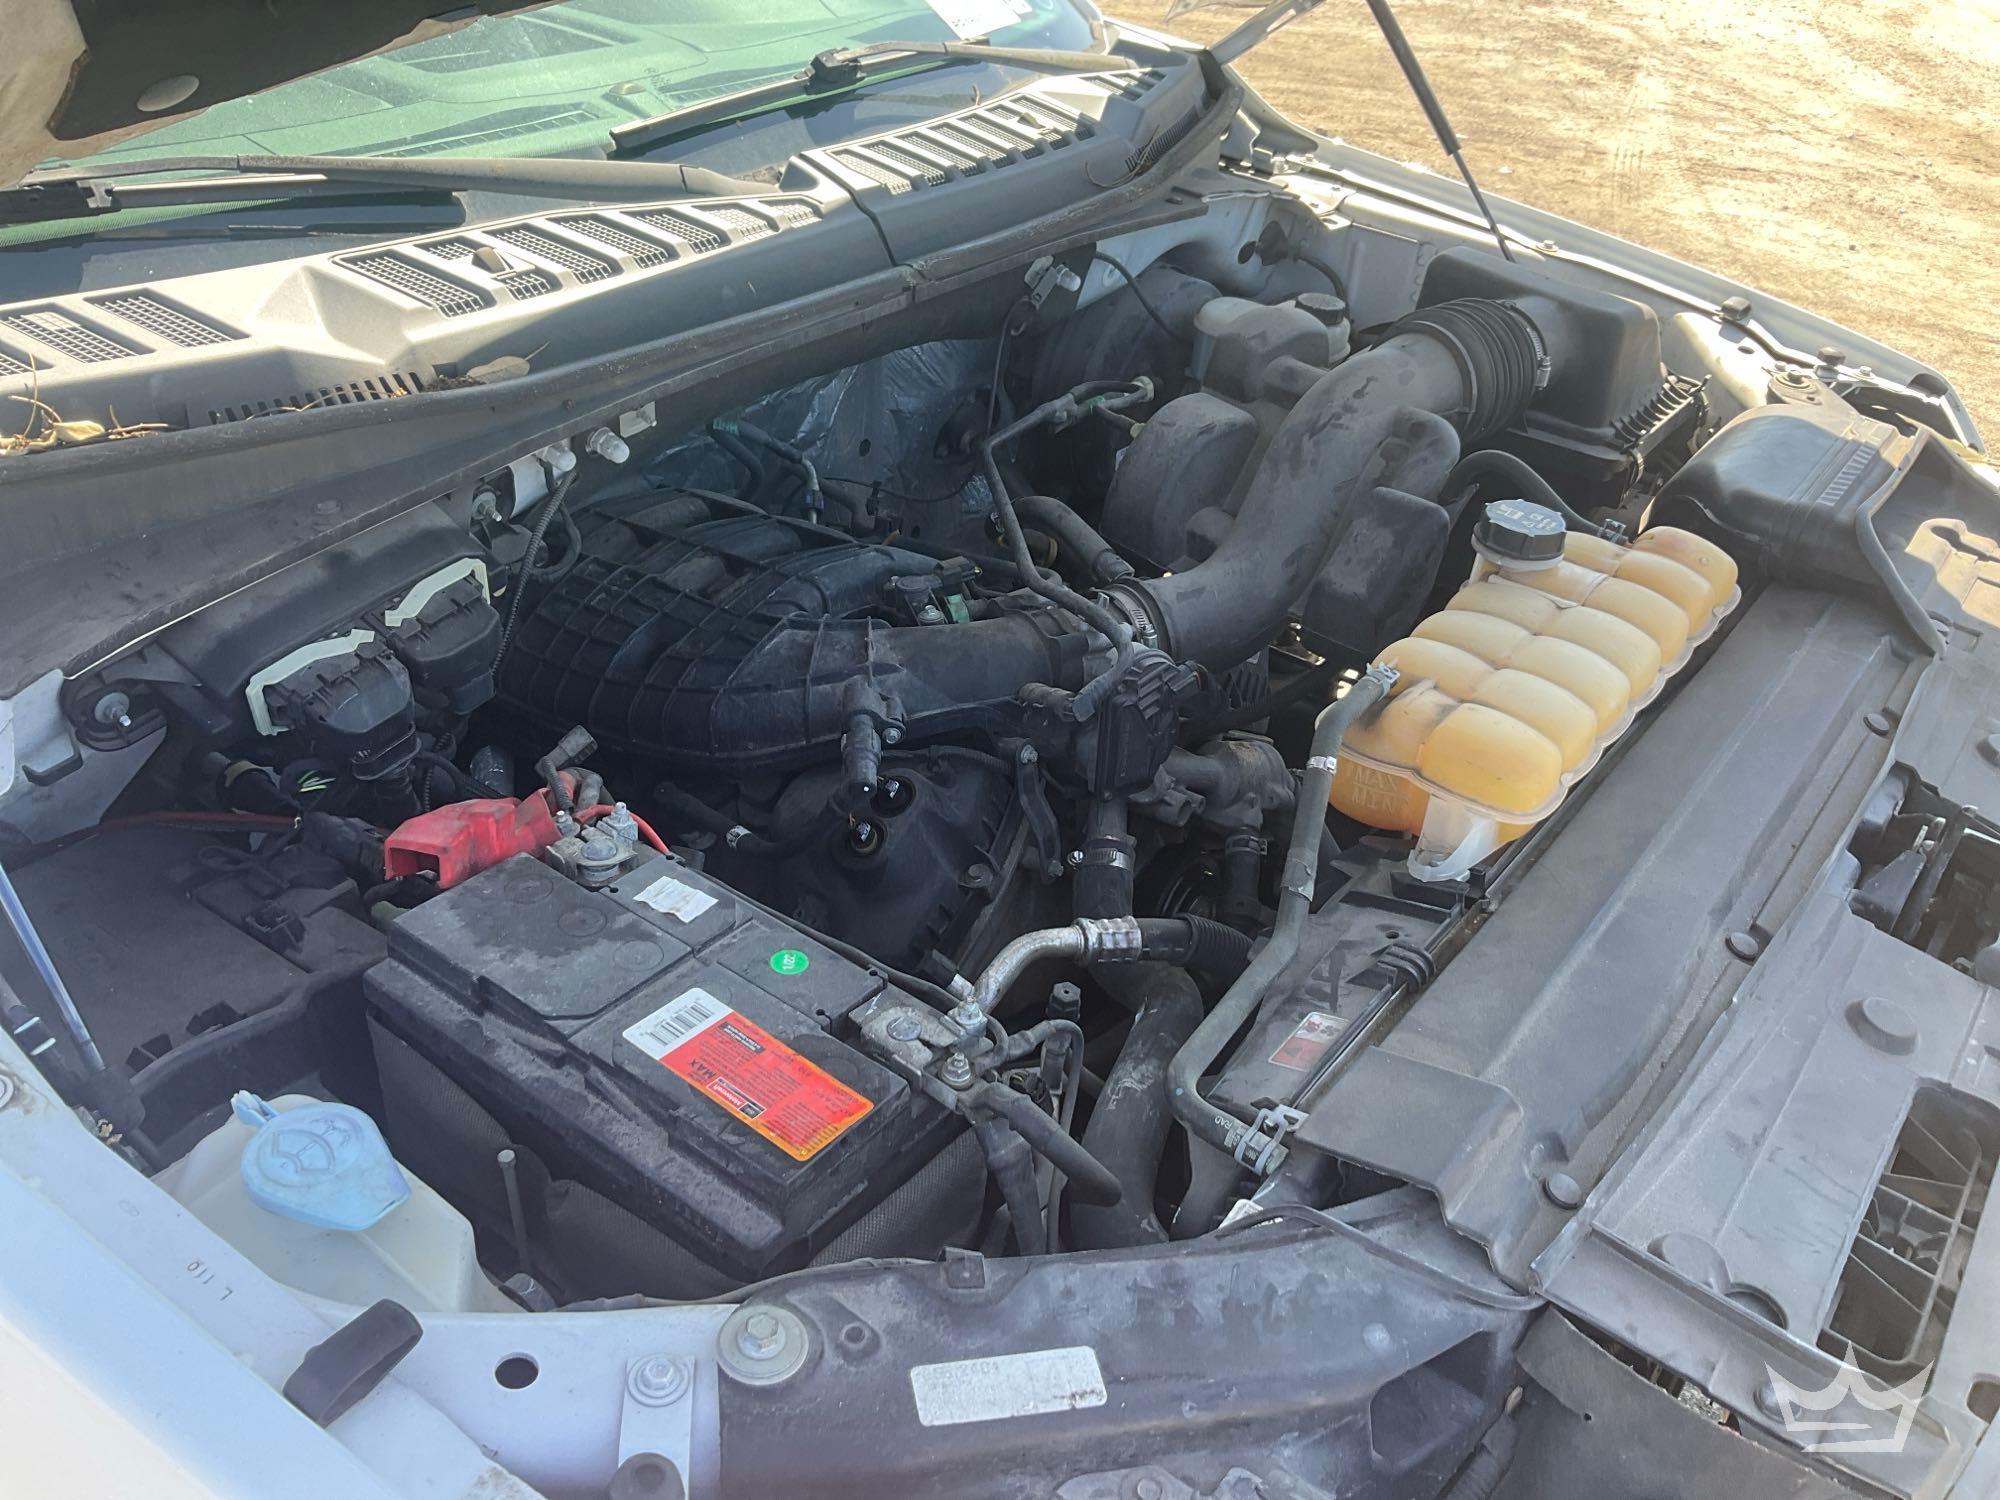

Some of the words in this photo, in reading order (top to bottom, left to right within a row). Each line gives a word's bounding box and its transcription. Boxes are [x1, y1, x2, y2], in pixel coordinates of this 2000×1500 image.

[1354, 766, 1397, 791] MAX
[1352, 786, 1396, 816] MIN
[688, 1059, 717, 1078] MAX
[1214, 1115, 1234, 1130] RAD
